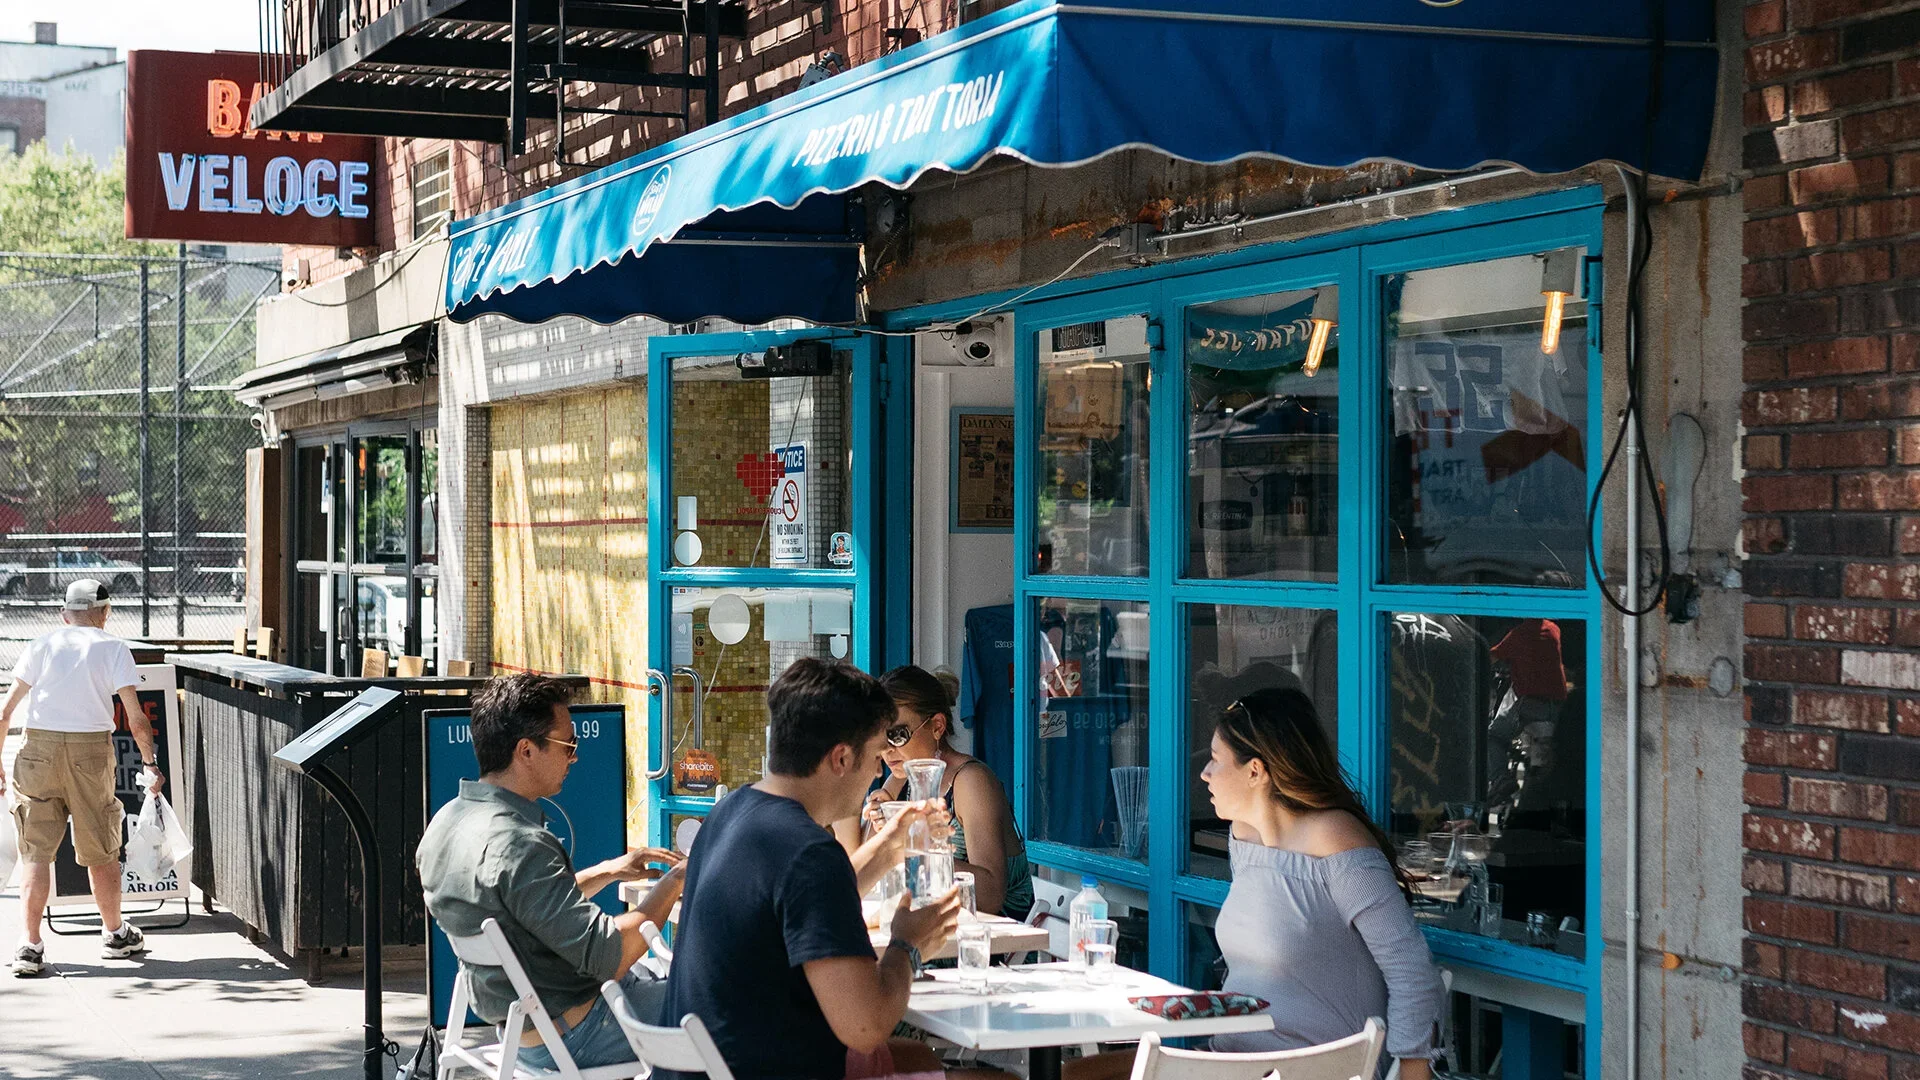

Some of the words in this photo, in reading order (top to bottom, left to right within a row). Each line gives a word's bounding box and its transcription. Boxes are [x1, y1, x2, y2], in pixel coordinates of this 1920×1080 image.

[792, 110, 880, 167] PIZZERIA
[892, 70, 1004, 144] TRATTORIA
[158, 152, 369, 218] VELOCE
[963, 419, 995, 429] DAILY
[777, 525, 783, 536] NO
[784, 523, 804, 536] SMOKING
[448, 724, 473, 744] LUN
[680, 761, 715, 772] sharebite
